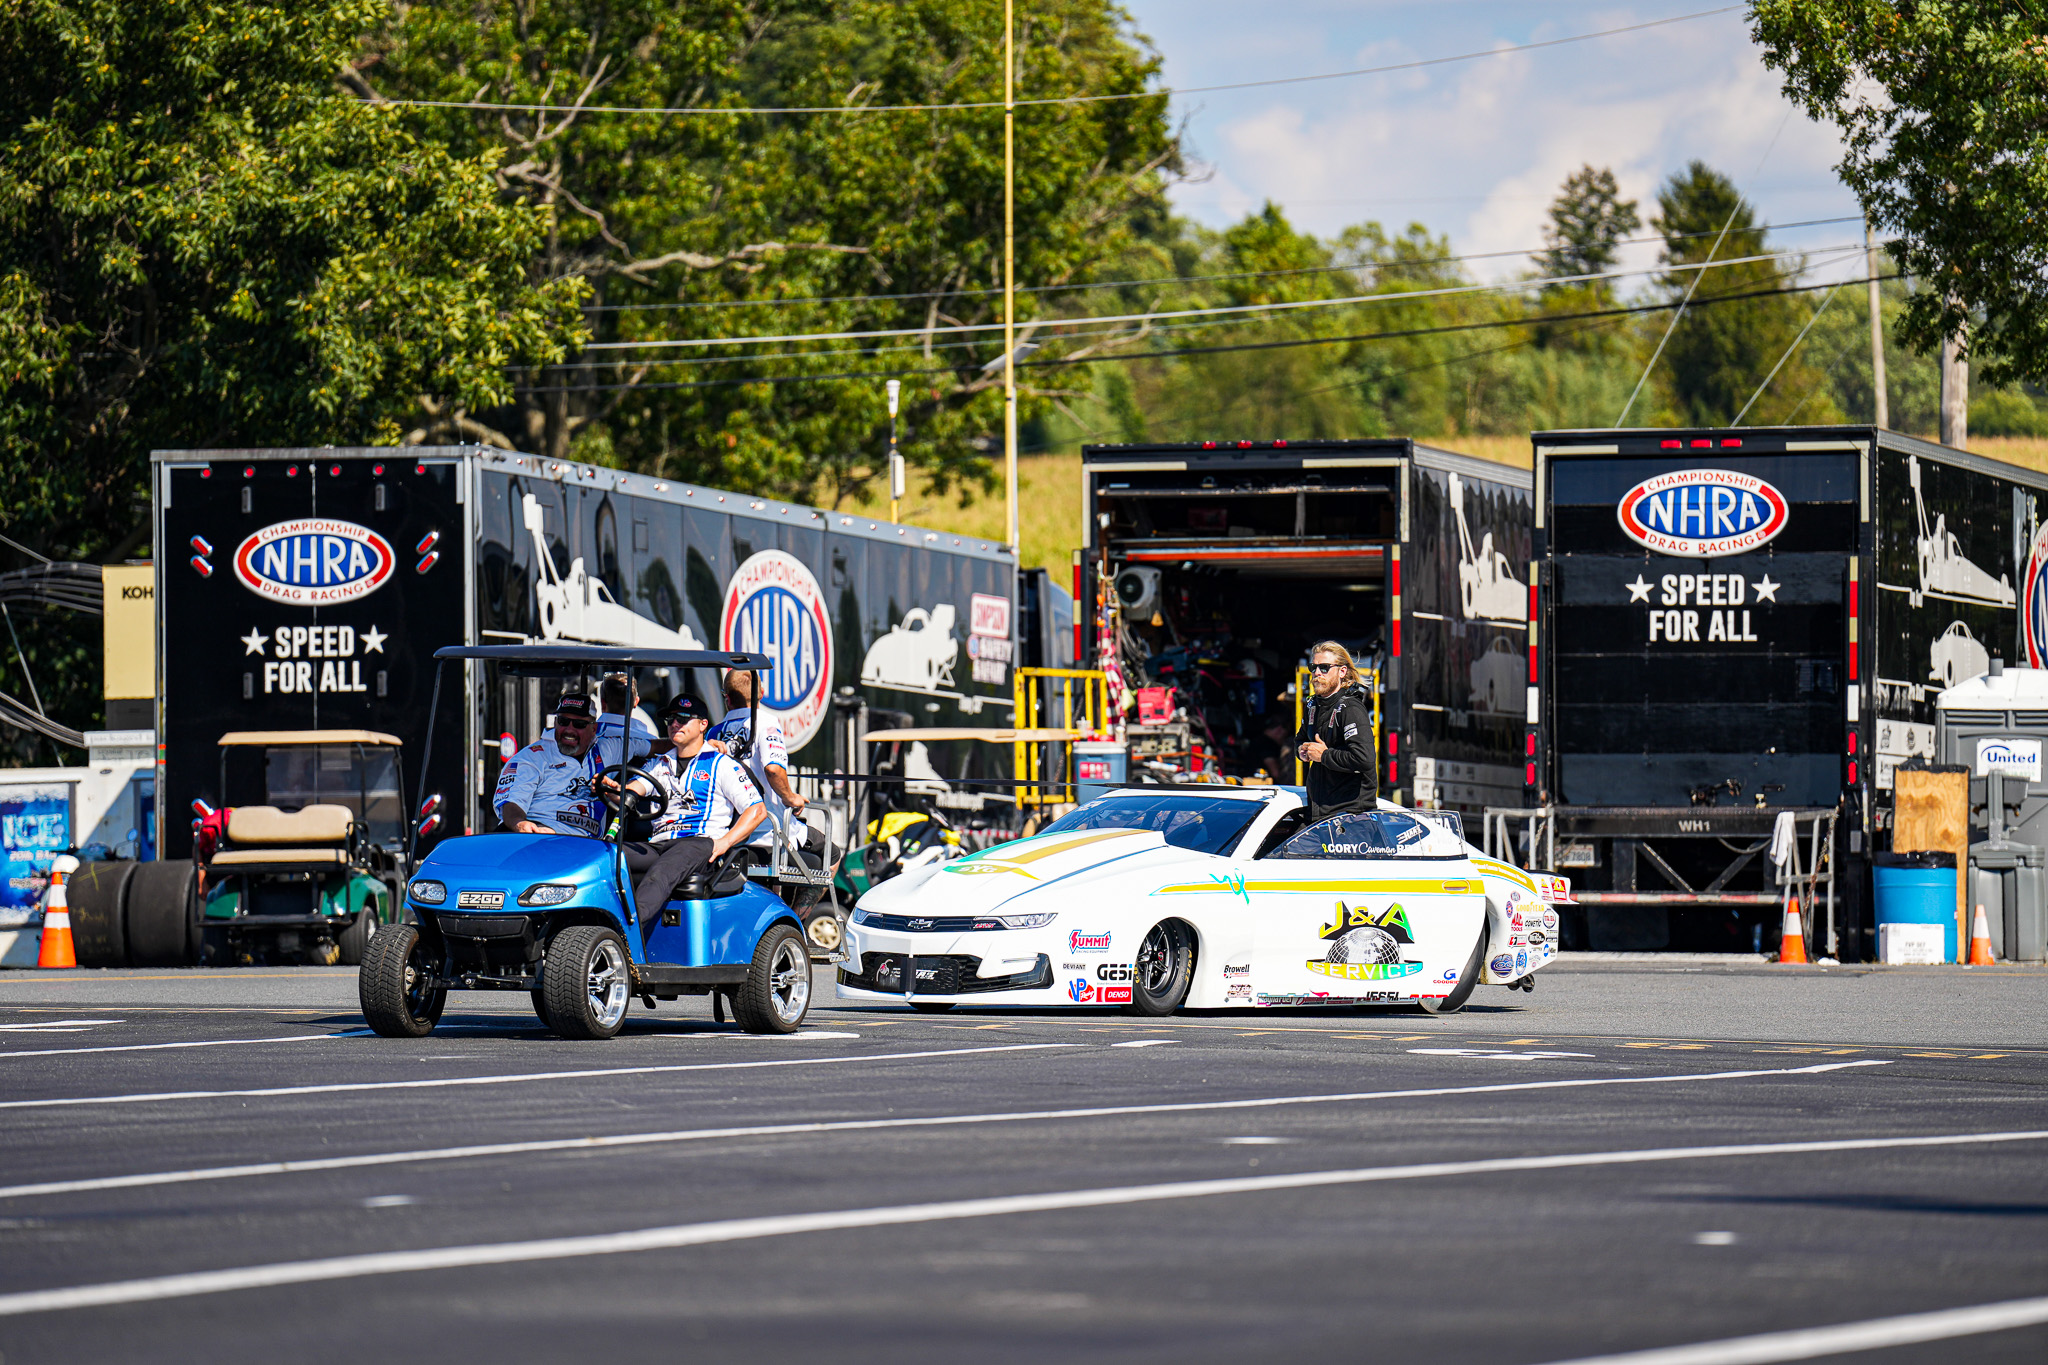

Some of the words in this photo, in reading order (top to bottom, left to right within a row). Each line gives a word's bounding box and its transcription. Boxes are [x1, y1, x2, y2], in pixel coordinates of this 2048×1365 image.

[1648, 472, 1757, 491] CHAMPIONSHIP
[1649, 486, 1761, 536] NHRA
[261, 521, 365, 540] CHAMPIONSHIP
[1648, 534, 1688, 552] DRAG
[1698, 534, 1754, 552] RACING
[263, 536, 370, 585] NHRA
[740, 561, 811, 597] CHAMPIONSHIP
[122, 586, 154, 599] KOH
[262, 582, 302, 599] DRAG
[311, 582, 364, 600] RACING
[1661, 574, 1745, 606] SPEED
[1649, 610, 1700, 642] FOR
[1708, 610, 1758, 642] ALL
[275, 626, 355, 658] SPEED
[741, 592, 816, 702] NHRA
[264, 661, 313, 693] FOR
[319, 660, 367, 692] ALL
[1988, 752, 2036, 763] United
[1679, 820, 1710, 832] WH1
[1328, 843, 1358, 854] CORY
[1319, 900, 1415, 943] J&A
[1224, 964, 1250, 973] Browell
[1311, 963, 1418, 979] SERVICE
[1069, 978, 1087, 1002] VP
